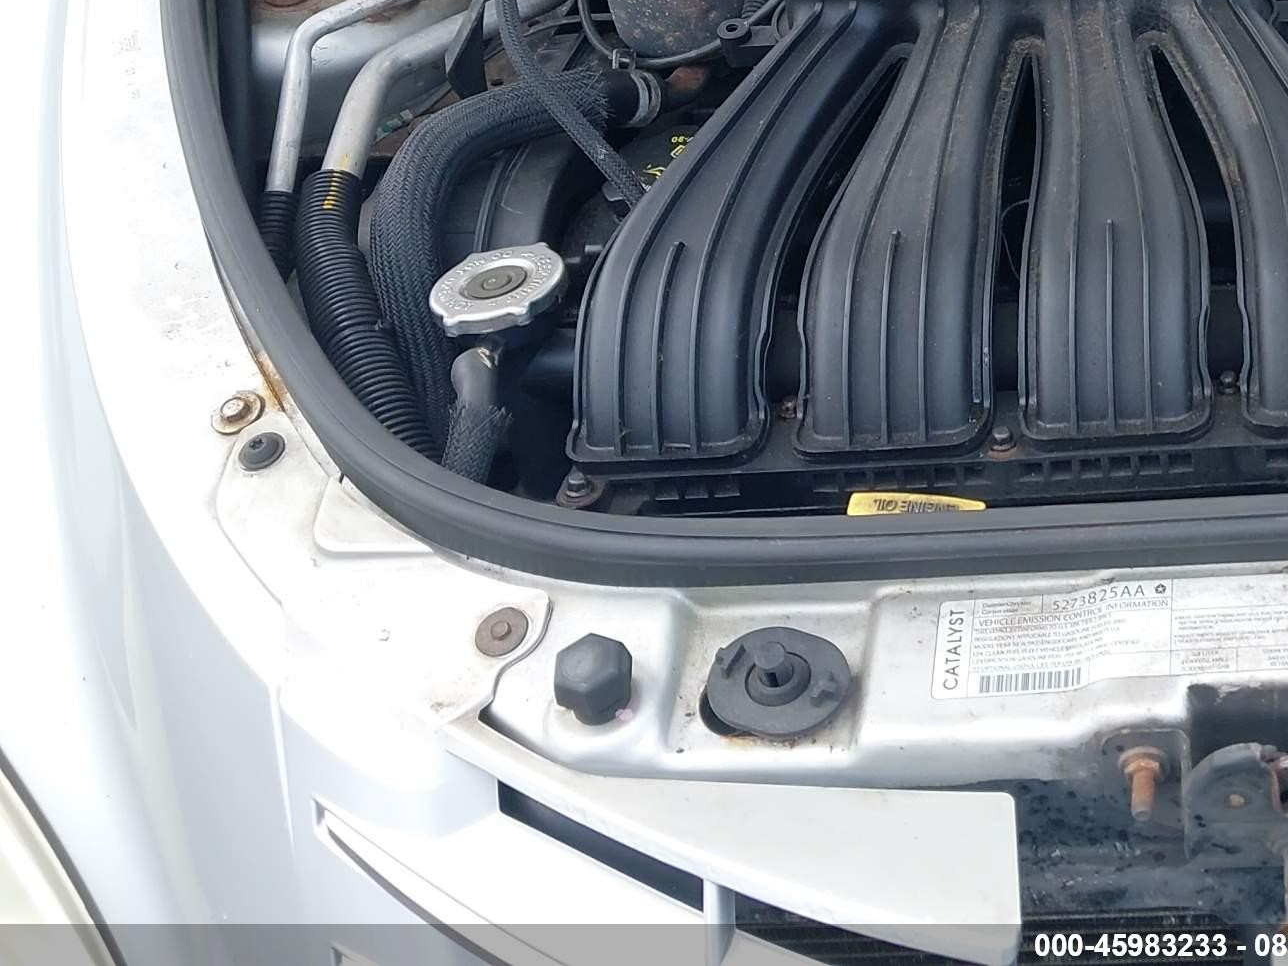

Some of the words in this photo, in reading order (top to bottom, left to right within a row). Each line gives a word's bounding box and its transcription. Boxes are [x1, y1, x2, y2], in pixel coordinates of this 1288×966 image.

[873, 497, 899, 512] OIL
[1053, 584, 1146, 611] 5273825AA
[978, 616, 1017, 627] VEHICLE
[1017, 613, 1062, 625] EMISSION
[1063, 607, 1103, 622] CONTROL
[1105, 599, 1169, 611] INFORMATION
[943, 609, 965, 691] CATALYST
